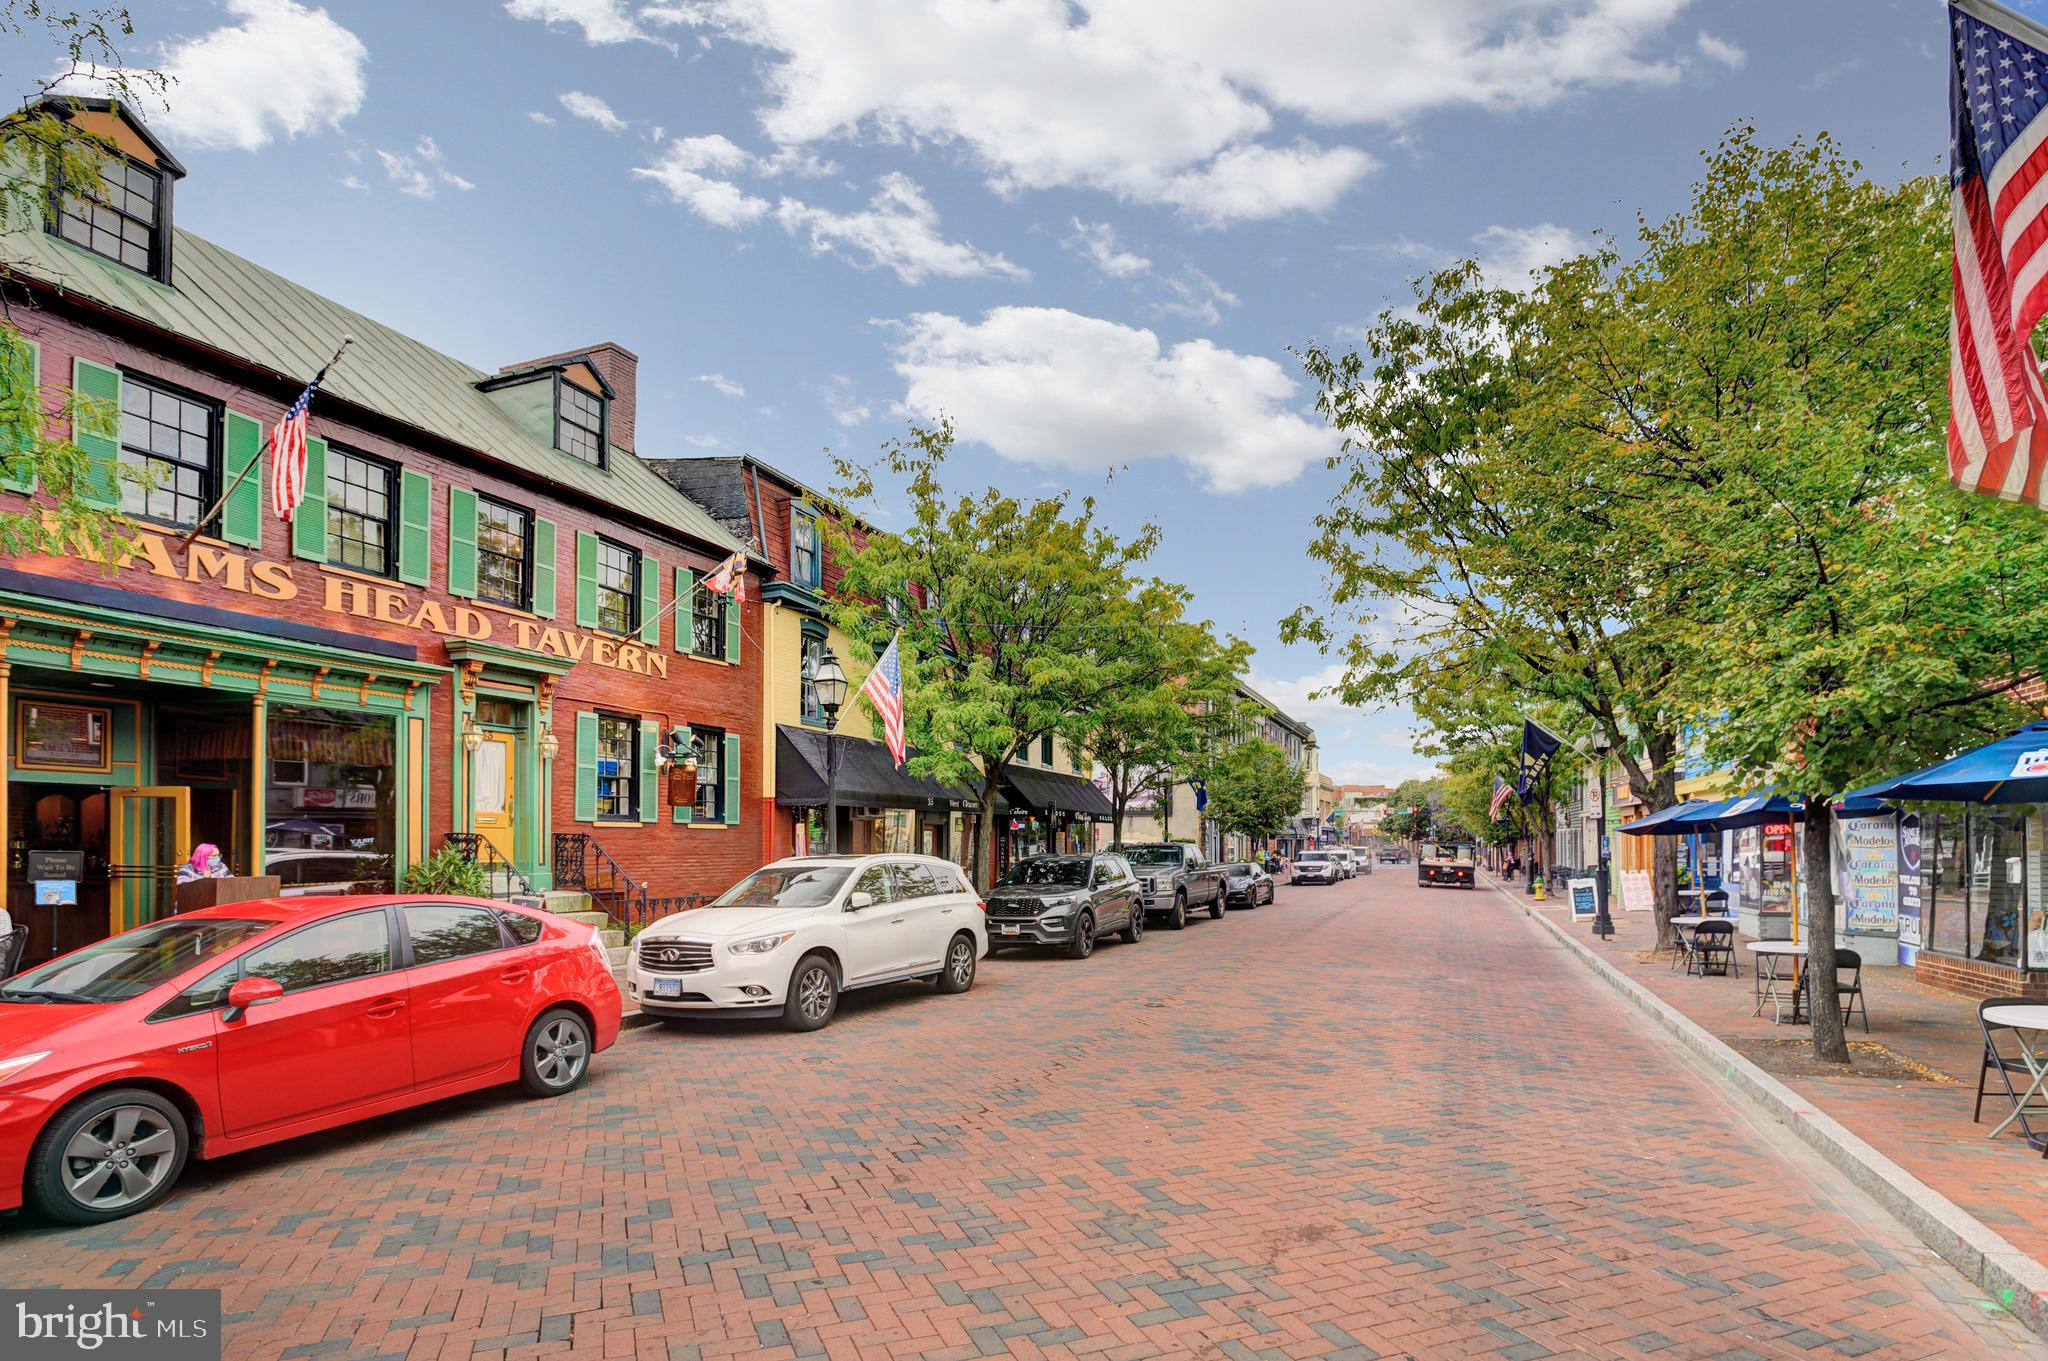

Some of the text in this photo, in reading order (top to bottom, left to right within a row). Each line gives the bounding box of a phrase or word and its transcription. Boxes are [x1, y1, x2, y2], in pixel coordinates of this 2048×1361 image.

[321, 576, 492, 640] HEAD
[508, 618, 668, 679] TAVERN
[1764, 825, 1792, 835] OPEN
[1848, 820, 1894, 832] Corona
[1854, 834, 1890, 846] Modelo
[44, 856, 67, 864] Please
[1848, 860, 1894, 871] Corona
[44, 871, 67, 879] Seated
[1854, 873, 1890, 885] Modelo
[1849, 899, 1895, 910] Corona
[1854, 913, 1890, 925] Modelo
